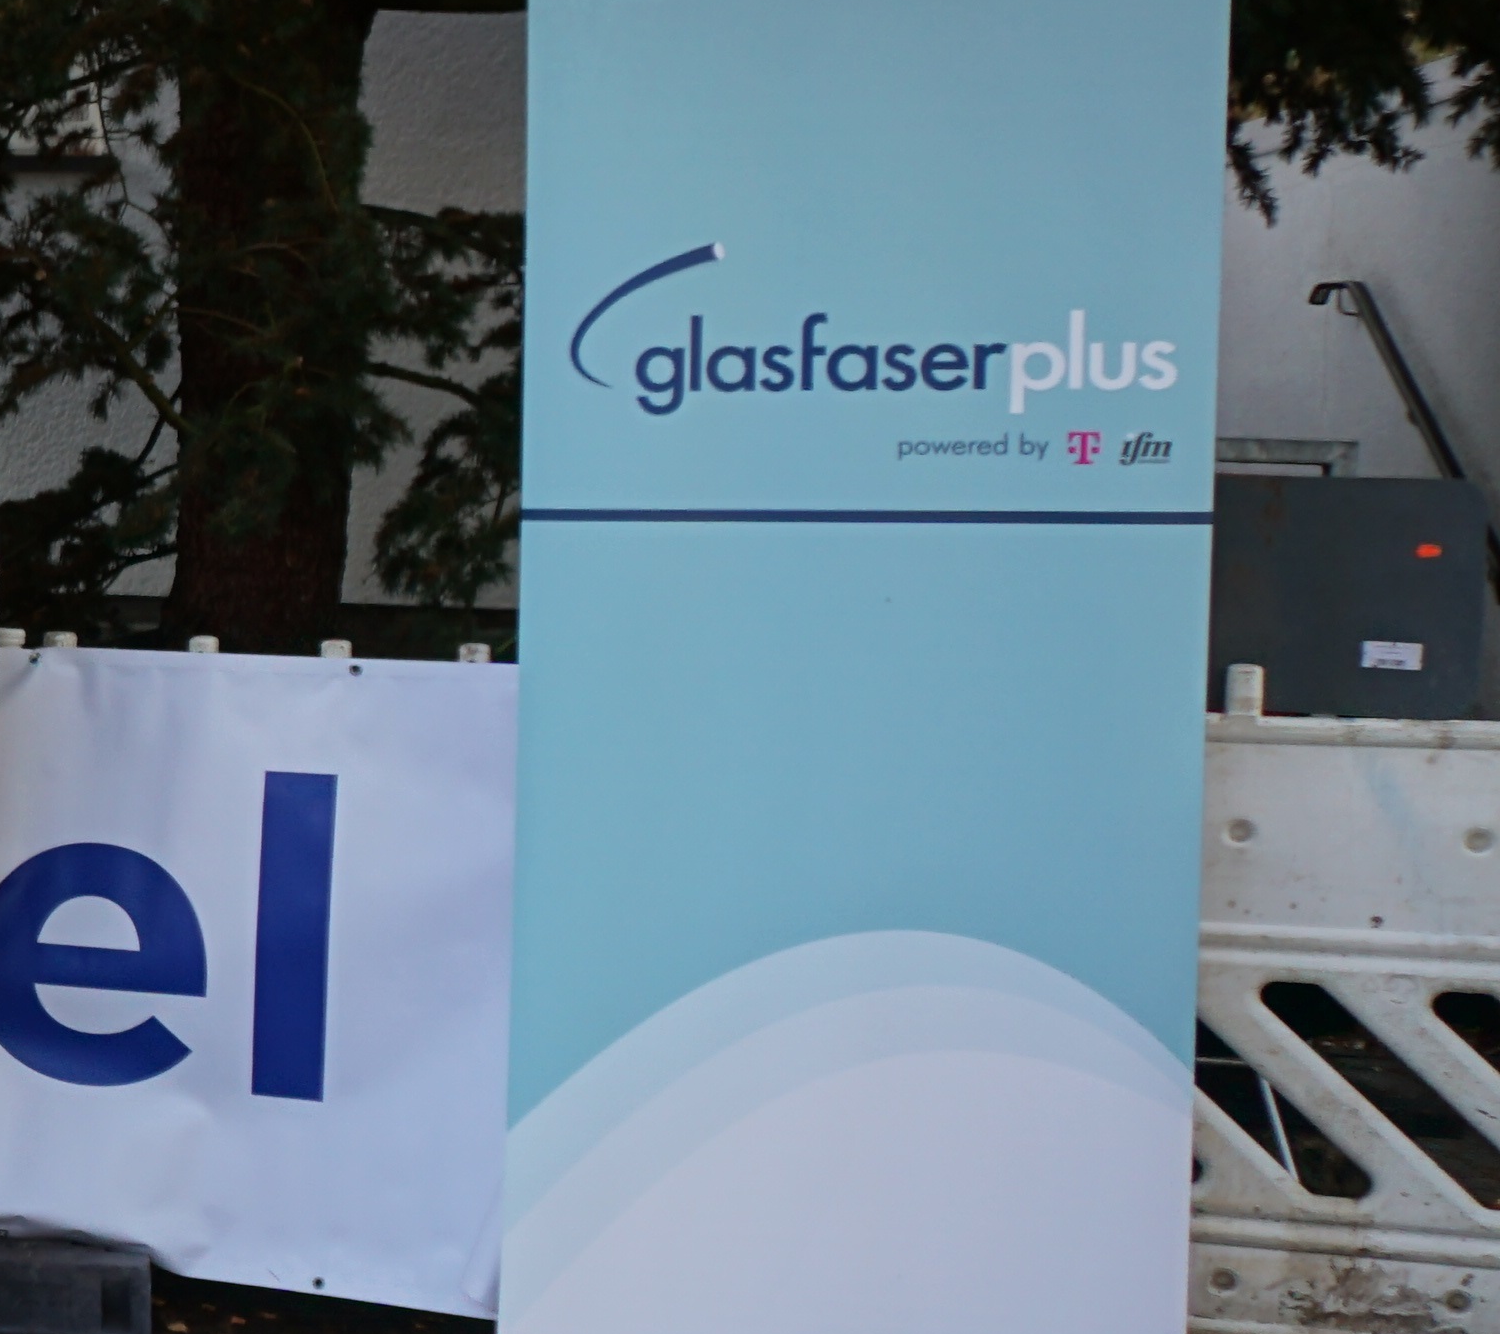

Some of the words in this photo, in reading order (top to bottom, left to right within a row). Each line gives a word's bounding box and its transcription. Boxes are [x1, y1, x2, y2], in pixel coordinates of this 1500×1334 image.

[635, 309, 1179, 416] glasfaserplus
[897, 432, 1009, 462] powered
[1019, 432, 1049, 460] by
